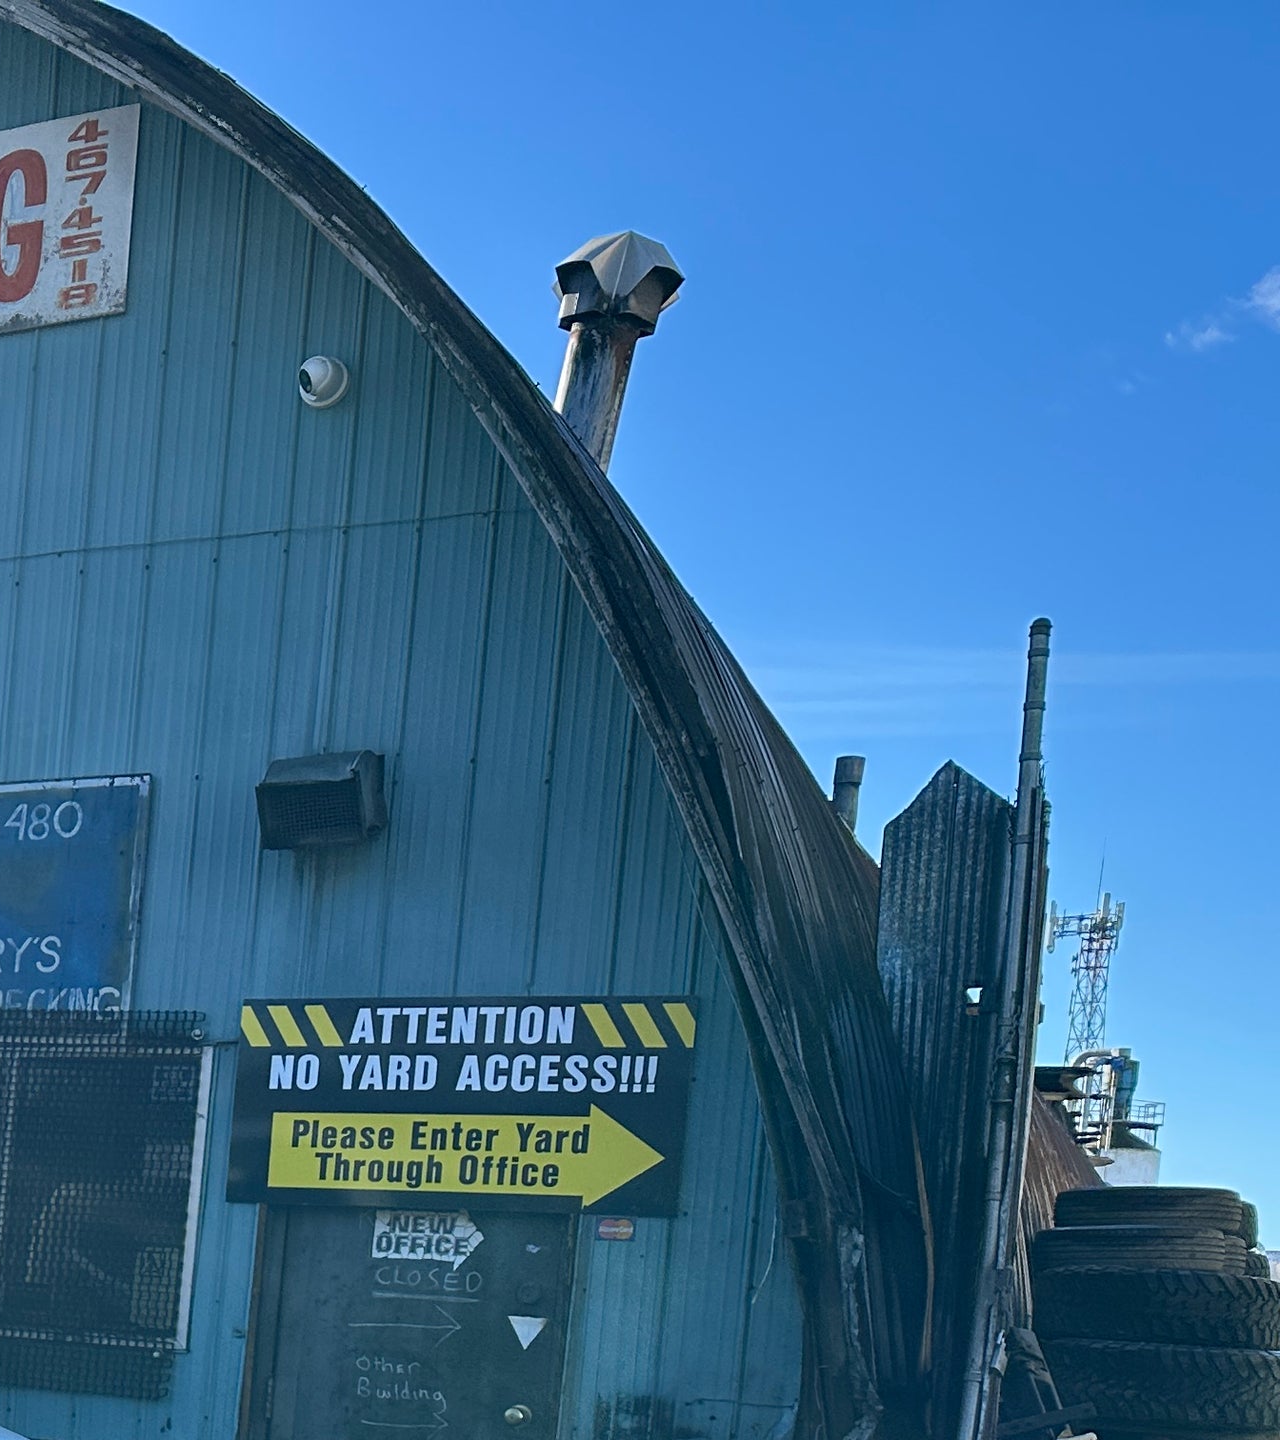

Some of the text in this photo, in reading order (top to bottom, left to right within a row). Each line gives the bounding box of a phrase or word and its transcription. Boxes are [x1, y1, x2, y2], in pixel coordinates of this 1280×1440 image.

[349, 1005, 576, 1045] ATTENTION
[268, 1054, 659, 1093] NO YARD ACCESS!!!
[291, 1119, 590, 1154] Please Enter Yard
[315, 1152, 559, 1189] Through Office
[389, 1214, 456, 1233] NEW
[376, 1231, 469, 1256] OFFICE
[376, 1265, 483, 1293] CLOSED
[357, 1376, 447, 1414] Building
